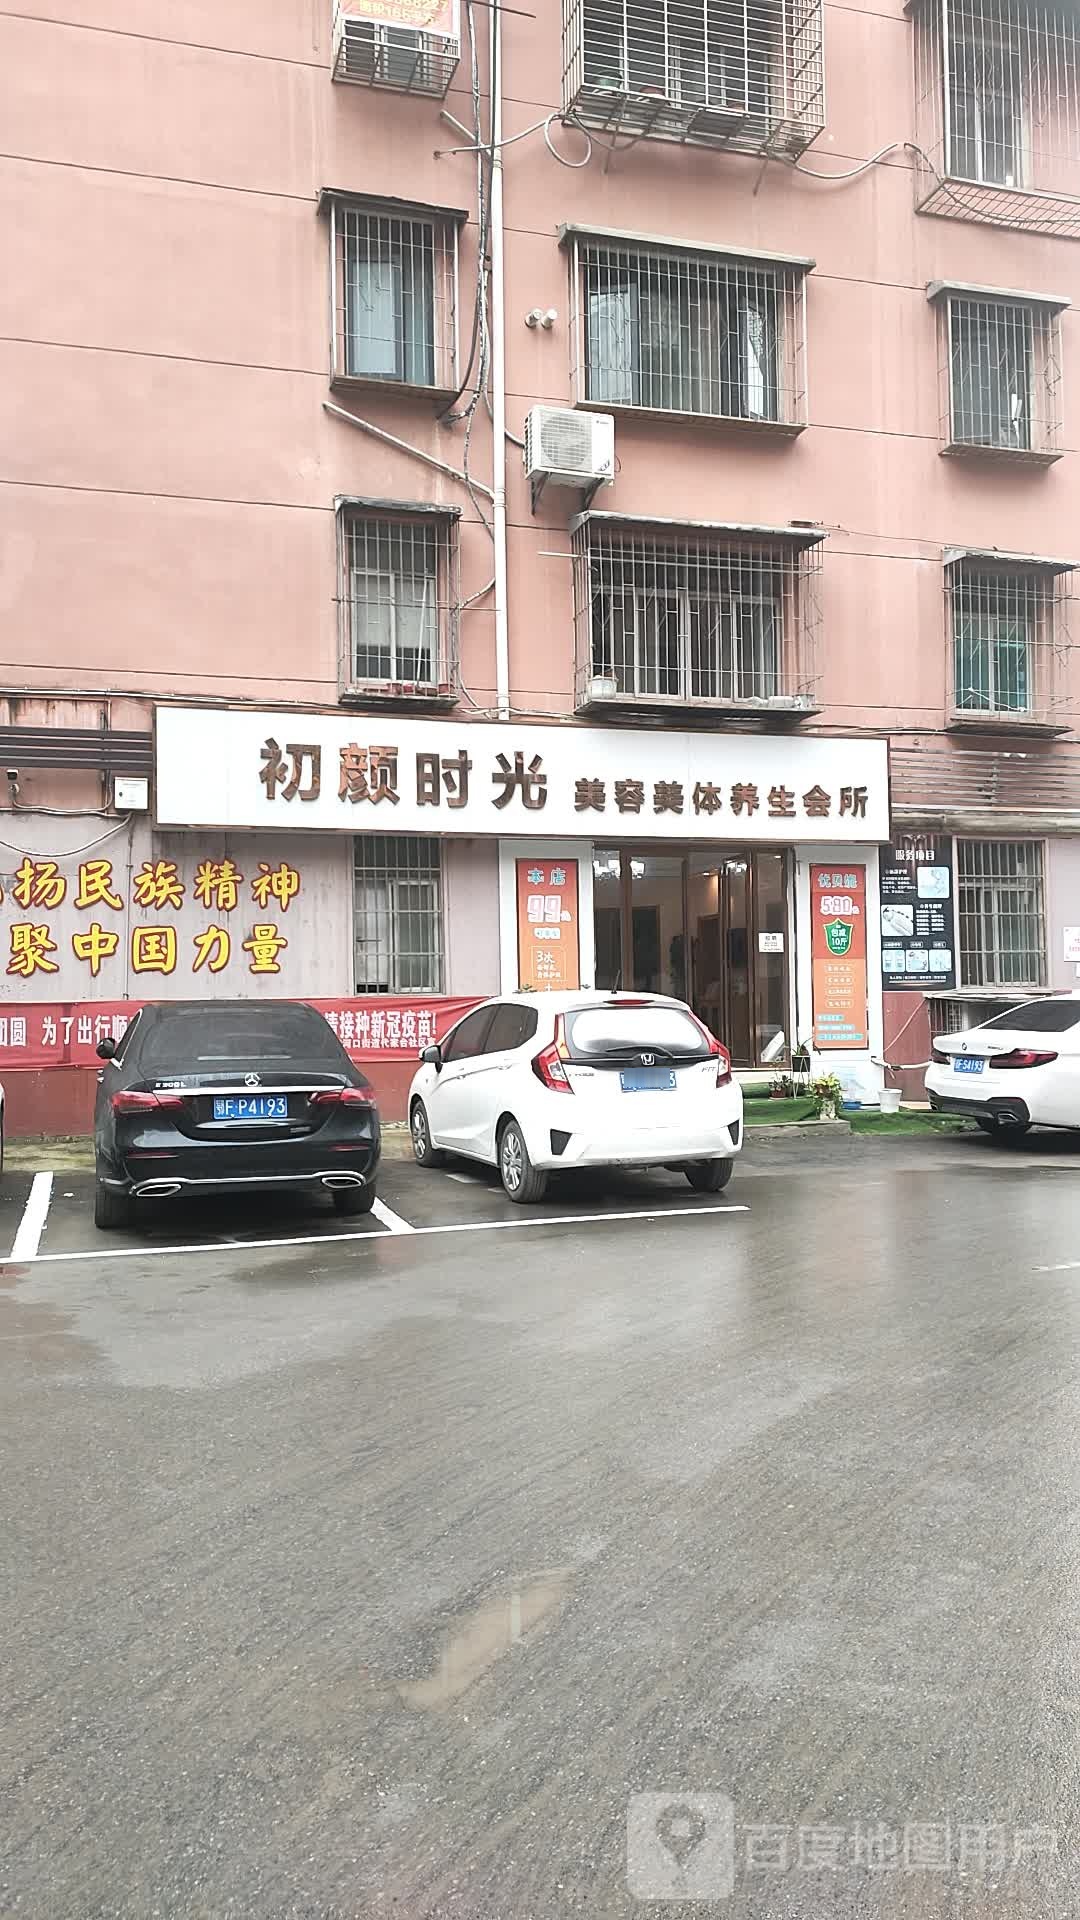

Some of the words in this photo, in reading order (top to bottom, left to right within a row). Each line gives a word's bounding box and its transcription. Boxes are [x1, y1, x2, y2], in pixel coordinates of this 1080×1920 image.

[259, 737, 547, 810] 初颜时光
[574, 777, 868, 818] 美容美体养生会所
[895, 849, 935, 861] 服务项目
[0, 857, 300, 912] 扬民族精神
[527, 867, 567, 885] 本店
[5, 922, 288, 977] 聚中国力量
[831, 937, 848, 947] 10斤
